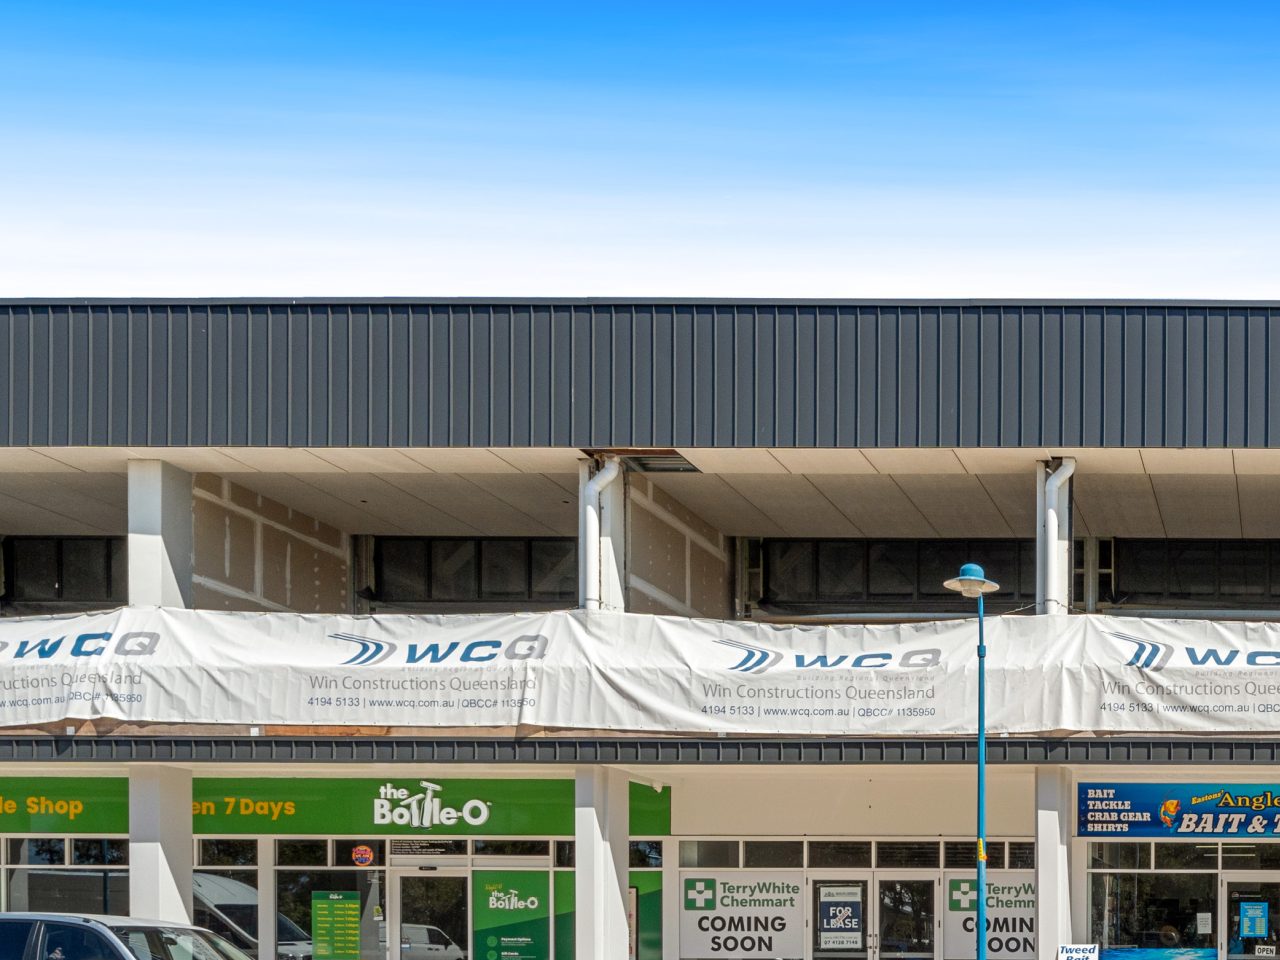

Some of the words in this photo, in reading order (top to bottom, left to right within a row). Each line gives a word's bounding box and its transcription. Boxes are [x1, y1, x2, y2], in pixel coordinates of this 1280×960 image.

[13, 632, 161, 658] WCQ
[406, 634, 549, 664] WCQ
[794, 648, 942, 668] WCQ
[309, 676, 338, 690] Win
[342, 676, 446, 690] Constructions
[1102, 681, 1131, 696] Win
[1135, 680, 1241, 696] Constructions
[702, 684, 732, 698] Win
[736, 684, 842, 700] Constructions
[845, 684, 935, 700] Queensland
[307, 698, 333, 707] 4194
[335, 698, 360, 707] 5133
[369, 699, 456, 709] www.wcq.com.au
[462, 700, 498, 708] QBCC#
[1100, 702, 1126, 712] 4194
[1128, 702, 1154, 712] 5133
[1162, 703, 1250, 714] www.wcq.com.au
[701, 706, 726, 715] 4194
[729, 706, 755, 716] 5133
[763, 706, 850, 717] www.wcq.com.au
[896, 707, 936, 717] 1135950
[379, 782, 409, 799] the
[1088, 789, 1116, 798] BAIT
[26, 796, 84, 820] Shop
[192, 801, 216, 816] en
[224, 798, 238, 815] 7
[240, 798, 296, 820] Days
[1088, 800, 1131, 810] TACKLE
[1088, 812, 1119, 822] CRAB
[1120, 812, 1152, 822] GEAR
[1177, 813, 1246, 834] BAIT
[1246, 814, 1268, 834] &
[1088, 823, 1129, 832] SHIRTS
[492, 890, 504, 898] the
[720, 882, 800, 898] TerryWhite
[720, 895, 796, 908] Chemmart
[830, 906, 852, 916] FOR
[698, 916, 787, 932] COMING
[824, 918, 859, 928] LEASE
[710, 936, 773, 952] SOON
[1060, 945, 1097, 954] Tweed
